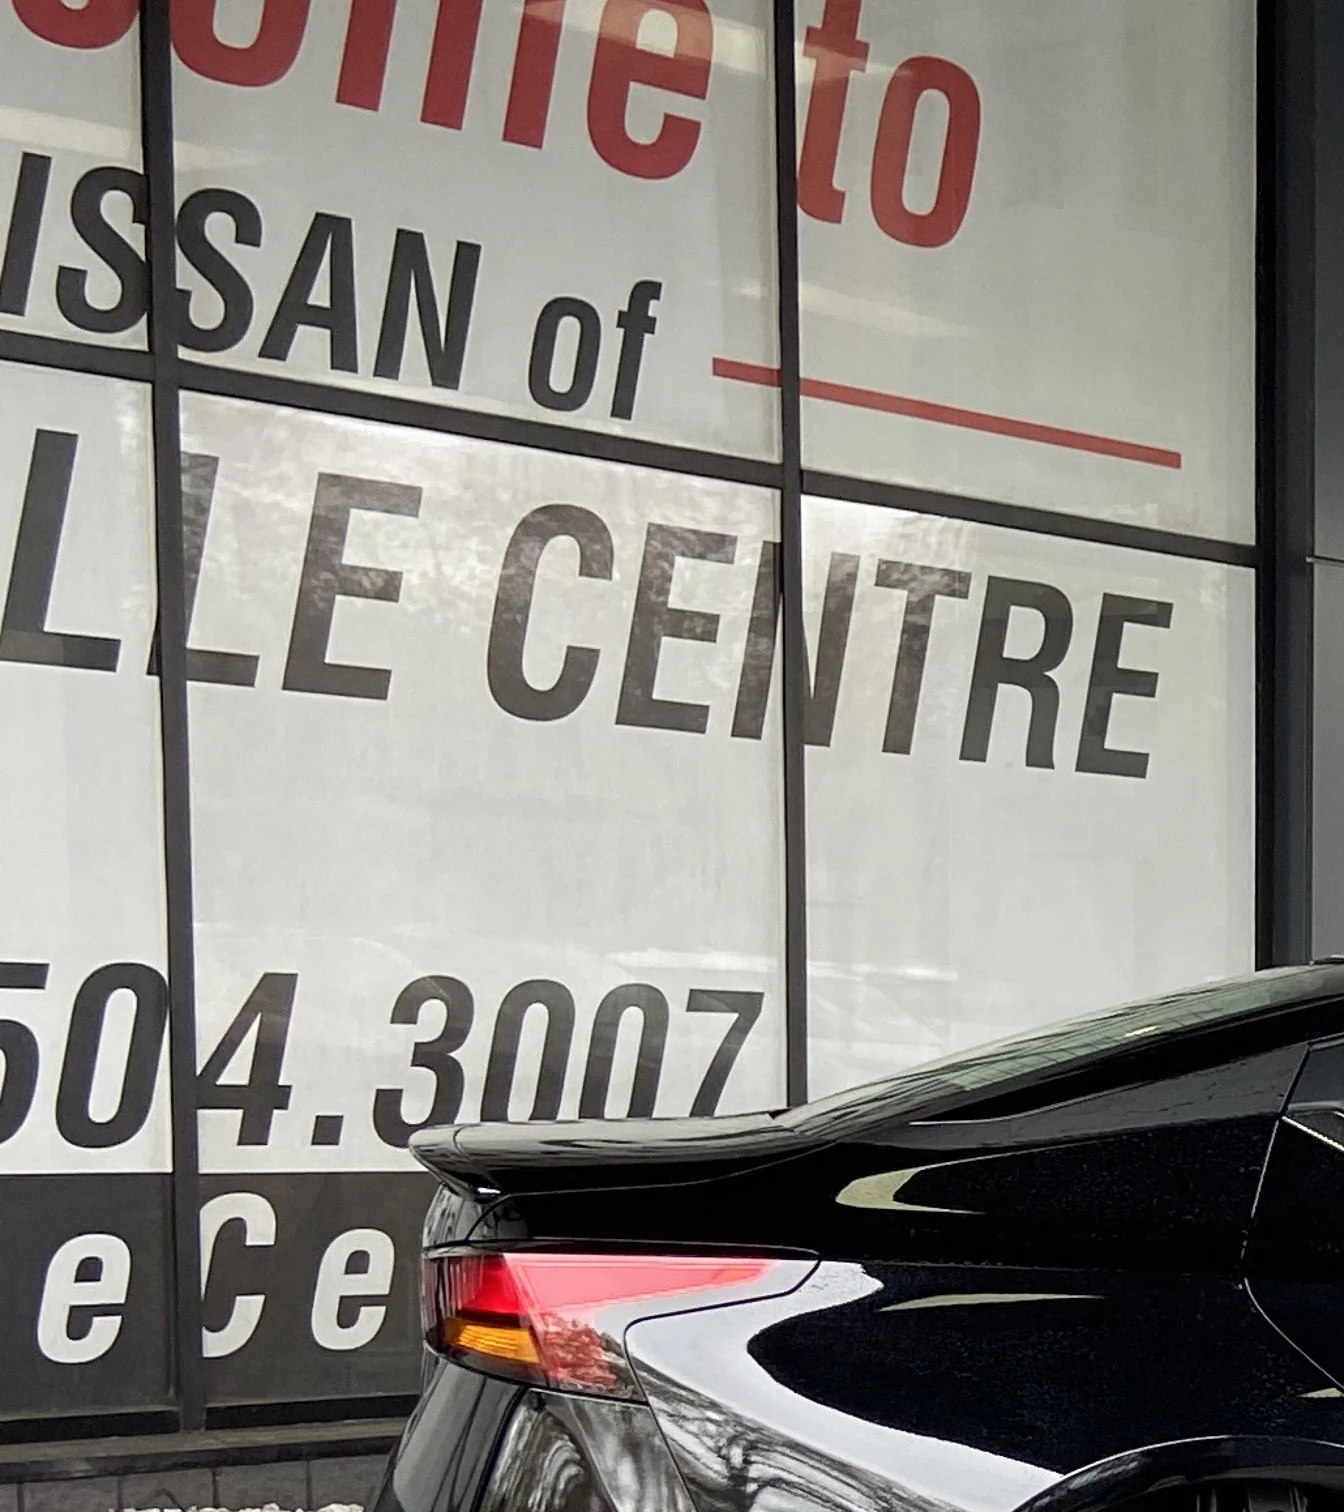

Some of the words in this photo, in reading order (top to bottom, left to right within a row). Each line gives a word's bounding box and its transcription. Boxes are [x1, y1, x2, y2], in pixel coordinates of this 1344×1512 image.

[796, 0, 981, 248] to
[528, 281, 663, 420] of
[486, 504, 1174, 780] CENTRE
